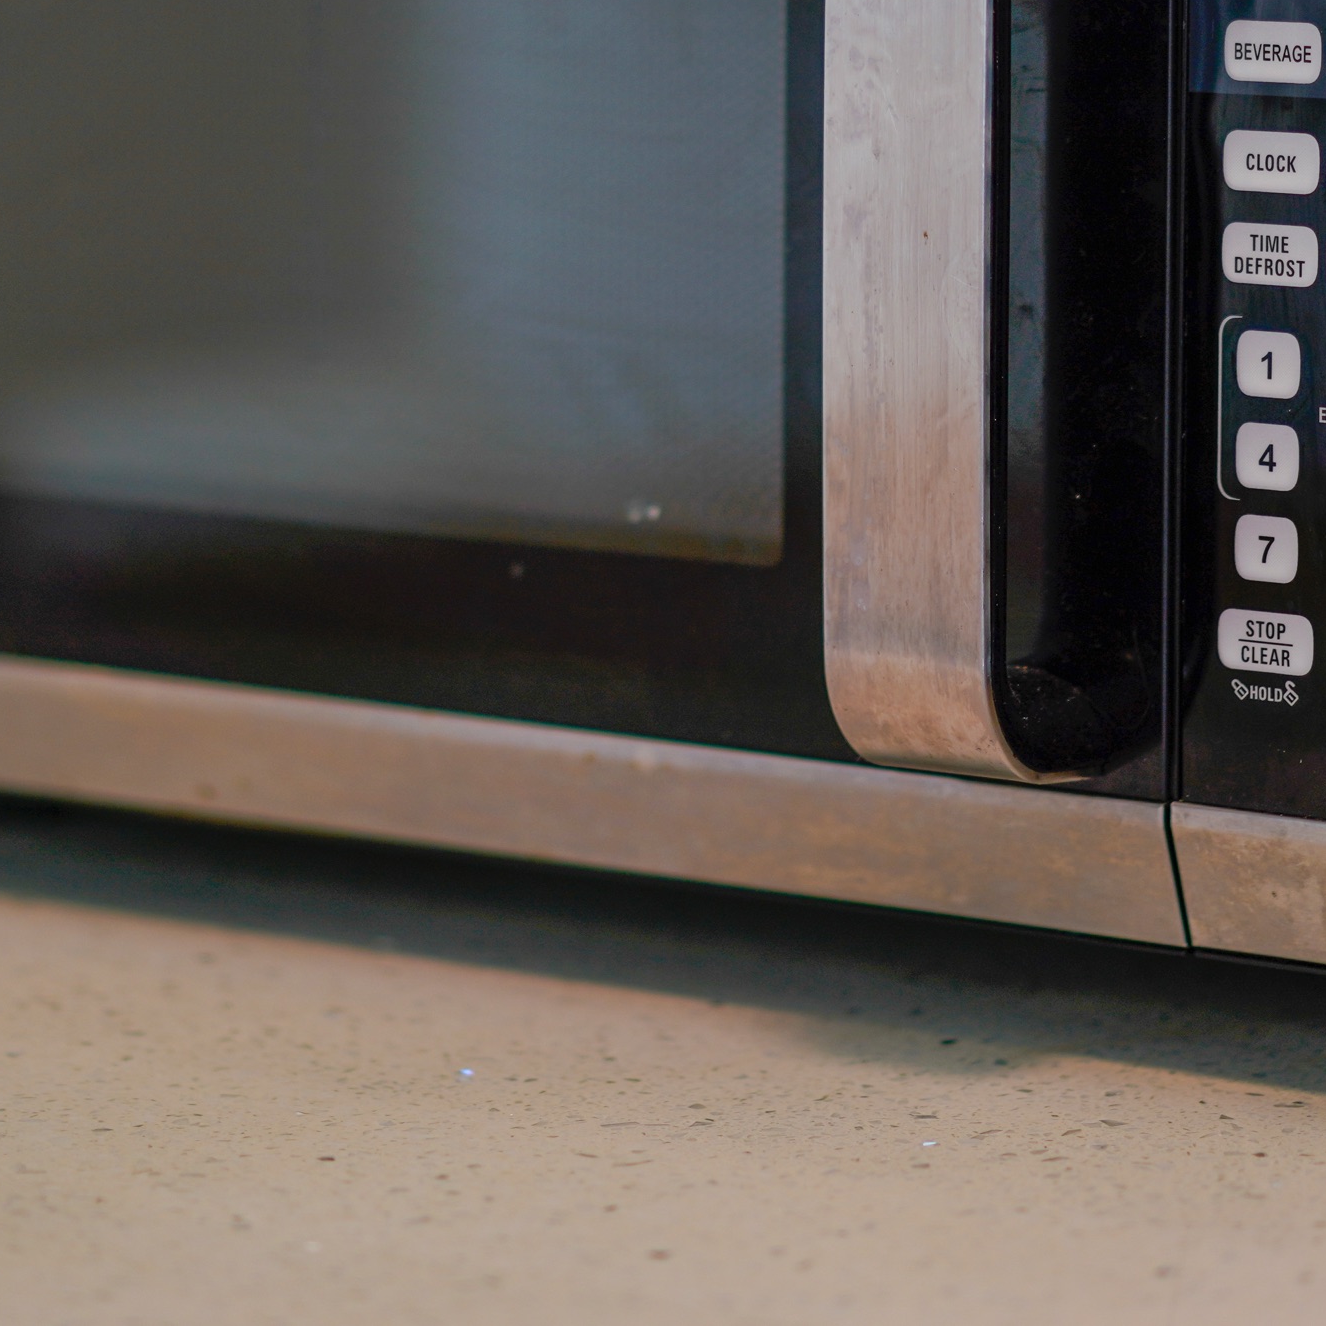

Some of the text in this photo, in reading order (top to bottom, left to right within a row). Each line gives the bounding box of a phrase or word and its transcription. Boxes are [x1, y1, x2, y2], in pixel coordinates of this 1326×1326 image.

[1234, 42, 1312, 64] BEVERAGE
[1246, 153, 1297, 173] CLOCK
[1249, 234, 1289, 254] TIME
[1234, 256, 1306, 278] DEFROST
[1261, 351, 1273, 380] 1
[1258, 443, 1277, 473] 4
[1258, 535, 1276, 564] 7
[1245, 619, 1286, 640] STOP
[1241, 645, 1290, 668] CLEAR
[1249, 685, 1283, 703] HOLD
